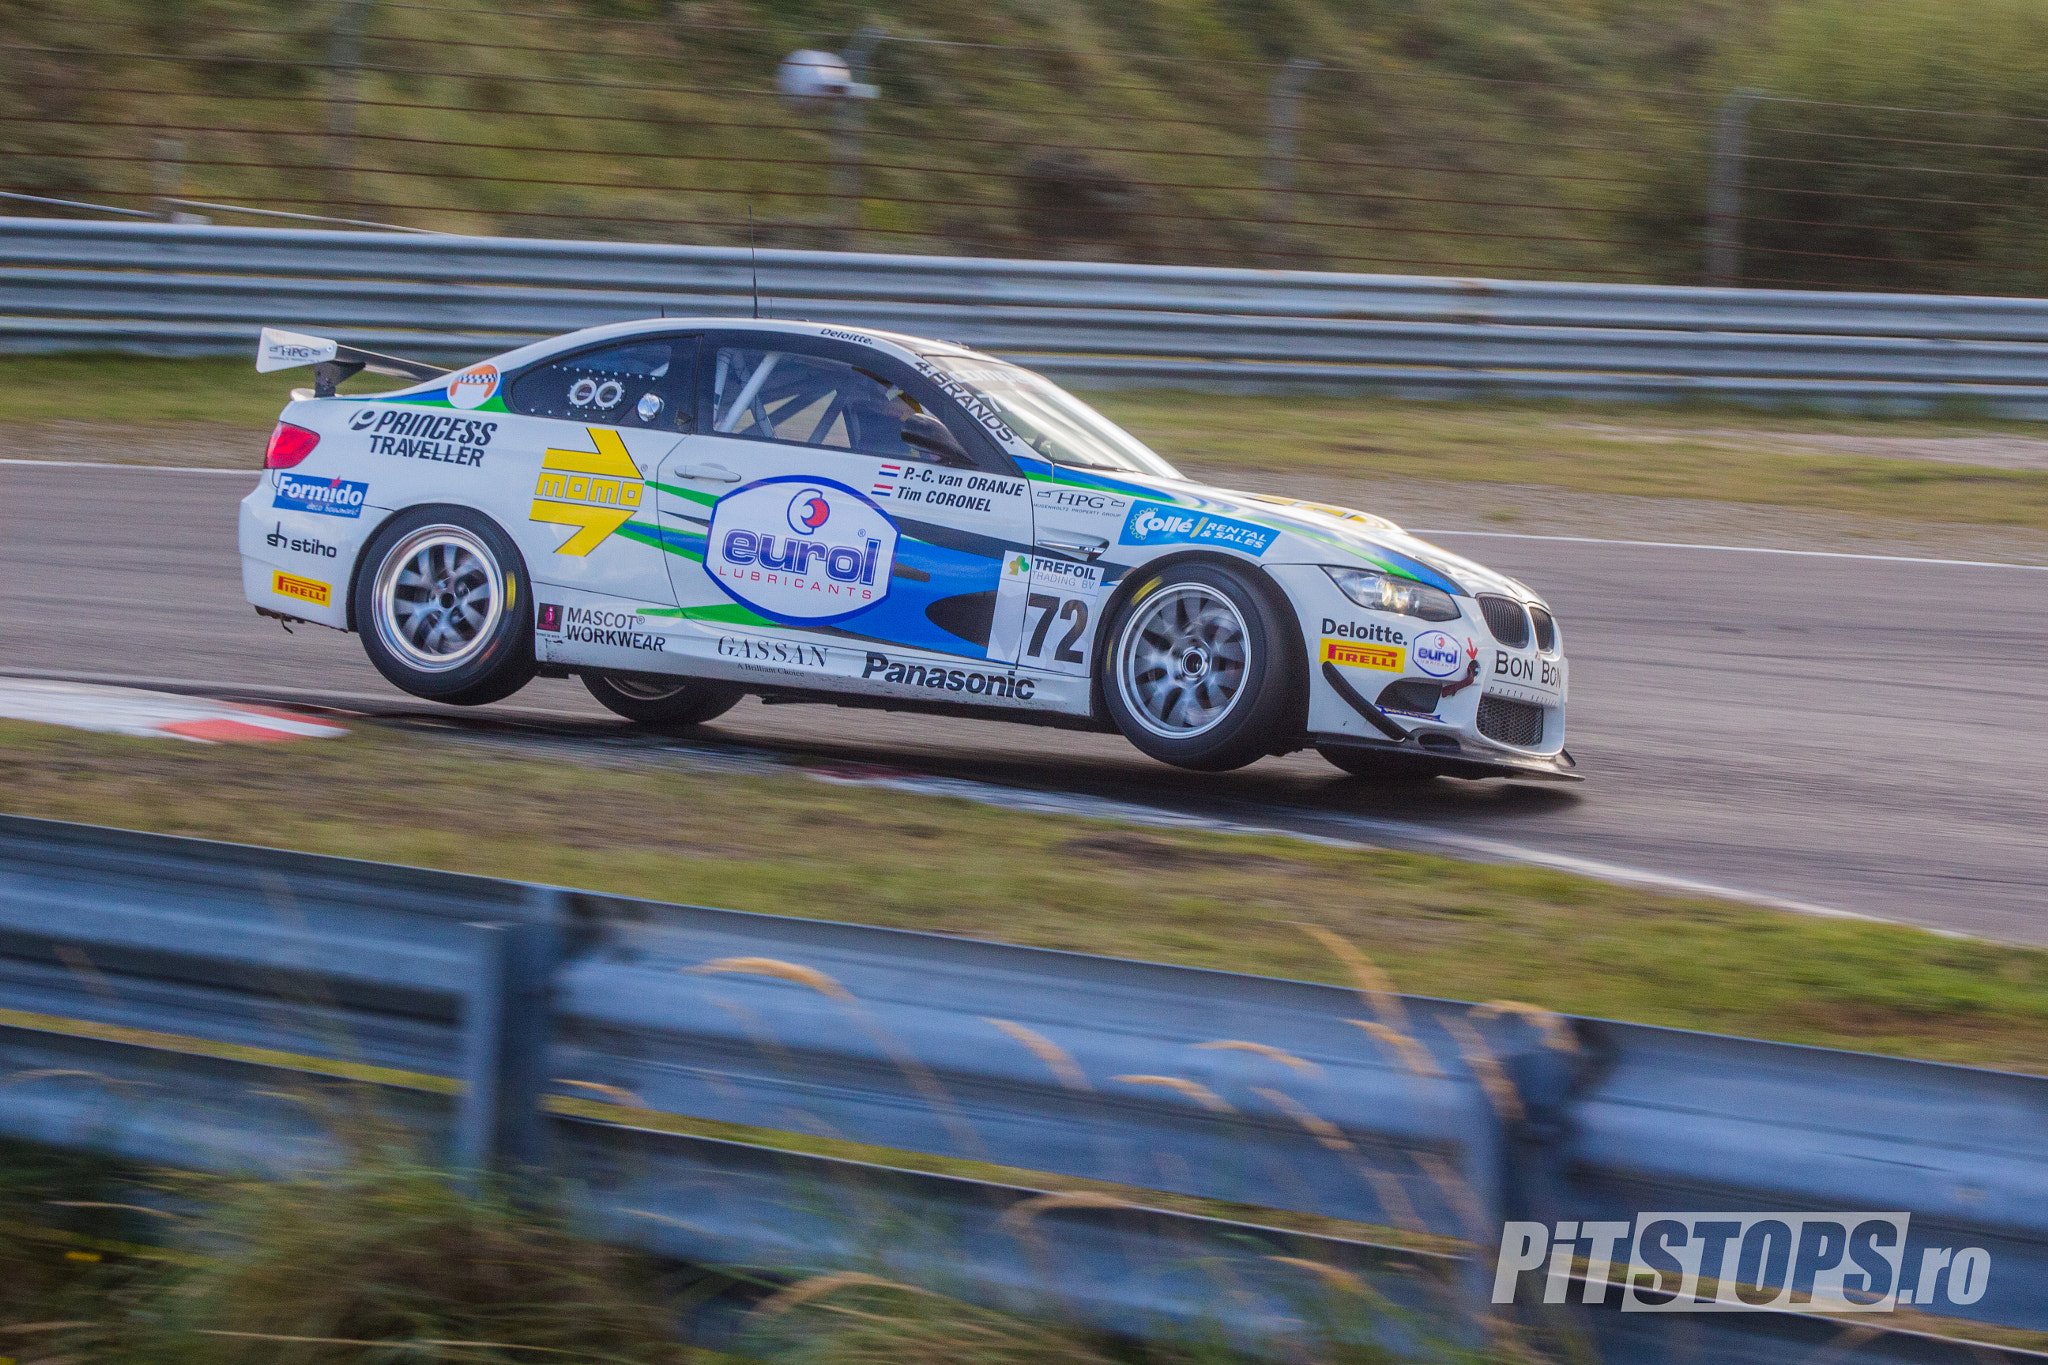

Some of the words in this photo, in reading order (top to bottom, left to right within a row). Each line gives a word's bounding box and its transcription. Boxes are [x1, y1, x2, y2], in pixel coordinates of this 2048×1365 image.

[820, 328, 873, 345] Deloitte.
[282, 346, 309, 357] HPG
[373, 410, 498, 446] PRINCESS
[370, 434, 485, 468] TRAVELLER
[277, 475, 363, 506] Formido
[938, 473, 963, 488] van
[966, 476, 1025, 497] ORANJE
[897, 486, 922, 502] Tim
[925, 490, 991, 512] CORONEL
[1056, 492, 1105, 509] HPG
[1134, 511, 1195, 537] Collé
[1206, 522, 1267, 543] RENTAL
[291, 538, 338, 558] stiho
[1200, 530, 1212, 538] &
[1213, 531, 1265, 549] SALES
[722, 528, 882, 587] eurol
[1034, 558, 1097, 581] TREFOIL
[277, 574, 328, 602] PIRELLI
[719, 566, 872, 600] LUBRICANTS
[1031, 570, 1076, 587] TRADING
[1081, 580, 1095, 590] BV
[566, 624, 666, 653] WORKWEAR
[1026, 592, 1089, 665] 72
[1321, 617, 1408, 646] Deloitte.
[717, 635, 829, 668] GASSAN
[1327, 643, 1398, 668] PIRELLI
[1418, 647, 1458, 665] eurol
[744, 663, 776, 674] Brilliant
[777, 667, 805, 677] Choice
[861, 651, 1036, 700] Panasonic
[1494, 649, 1534, 681] BON
[1541, 659, 1562, 688] BON
